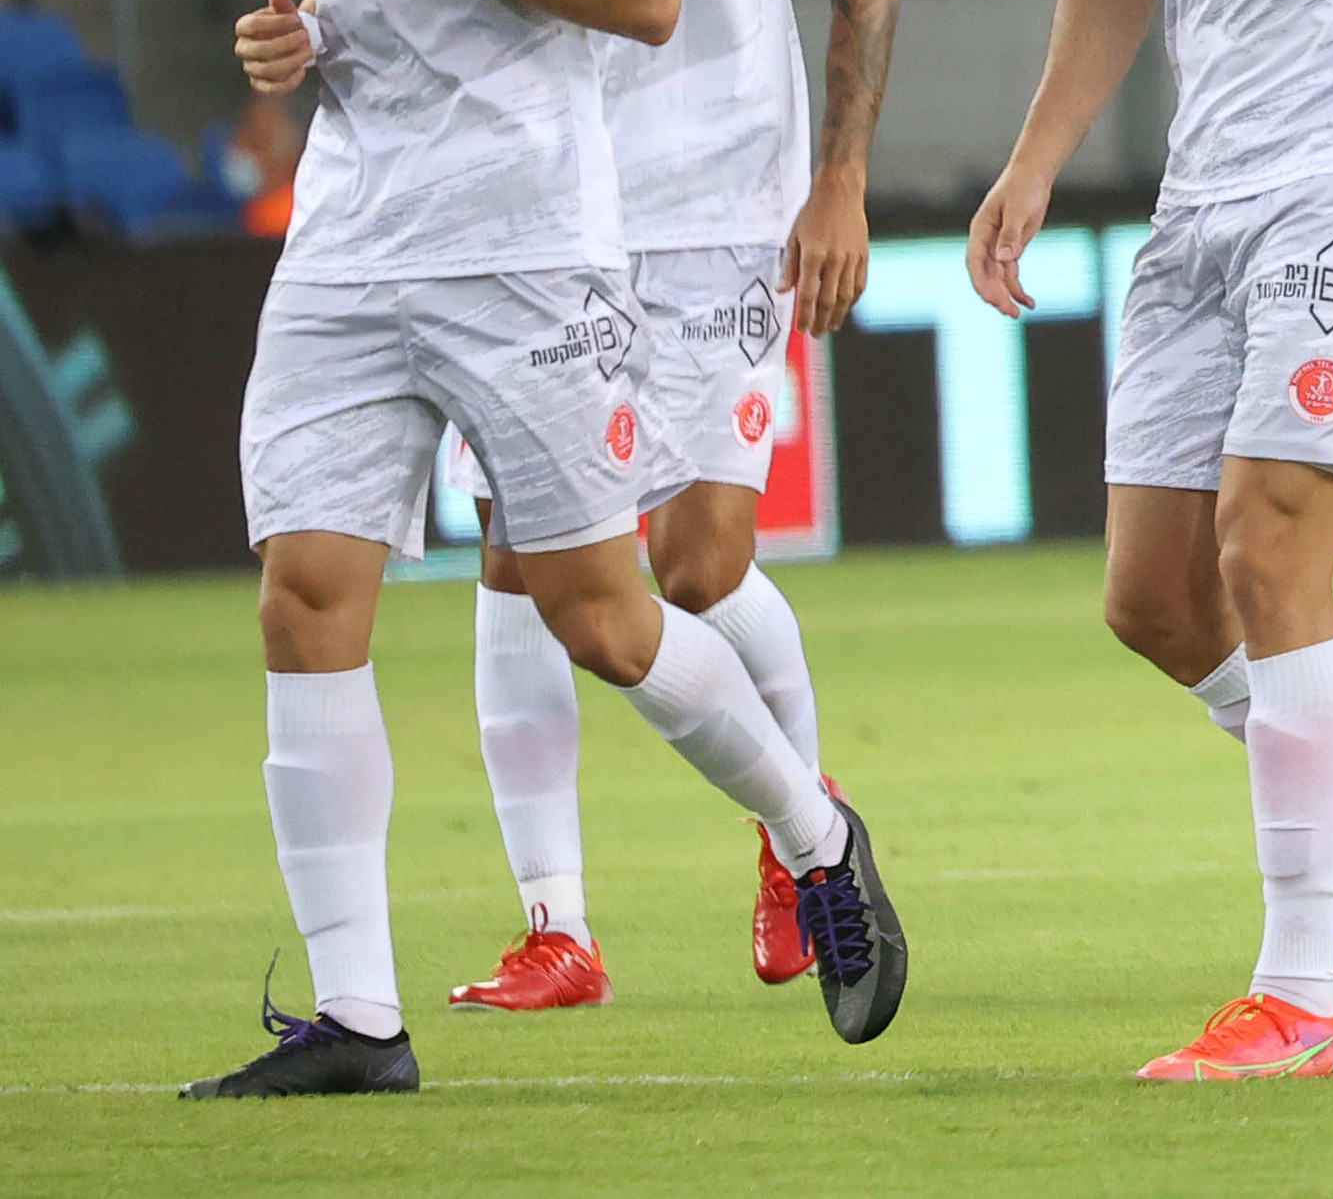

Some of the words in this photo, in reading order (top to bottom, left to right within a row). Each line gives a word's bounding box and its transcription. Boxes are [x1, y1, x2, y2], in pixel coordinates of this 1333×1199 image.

[1284, 264, 1309, 281] בית
[564, 321, 590, 342] בית
[530, 339, 593, 368] השקעות
